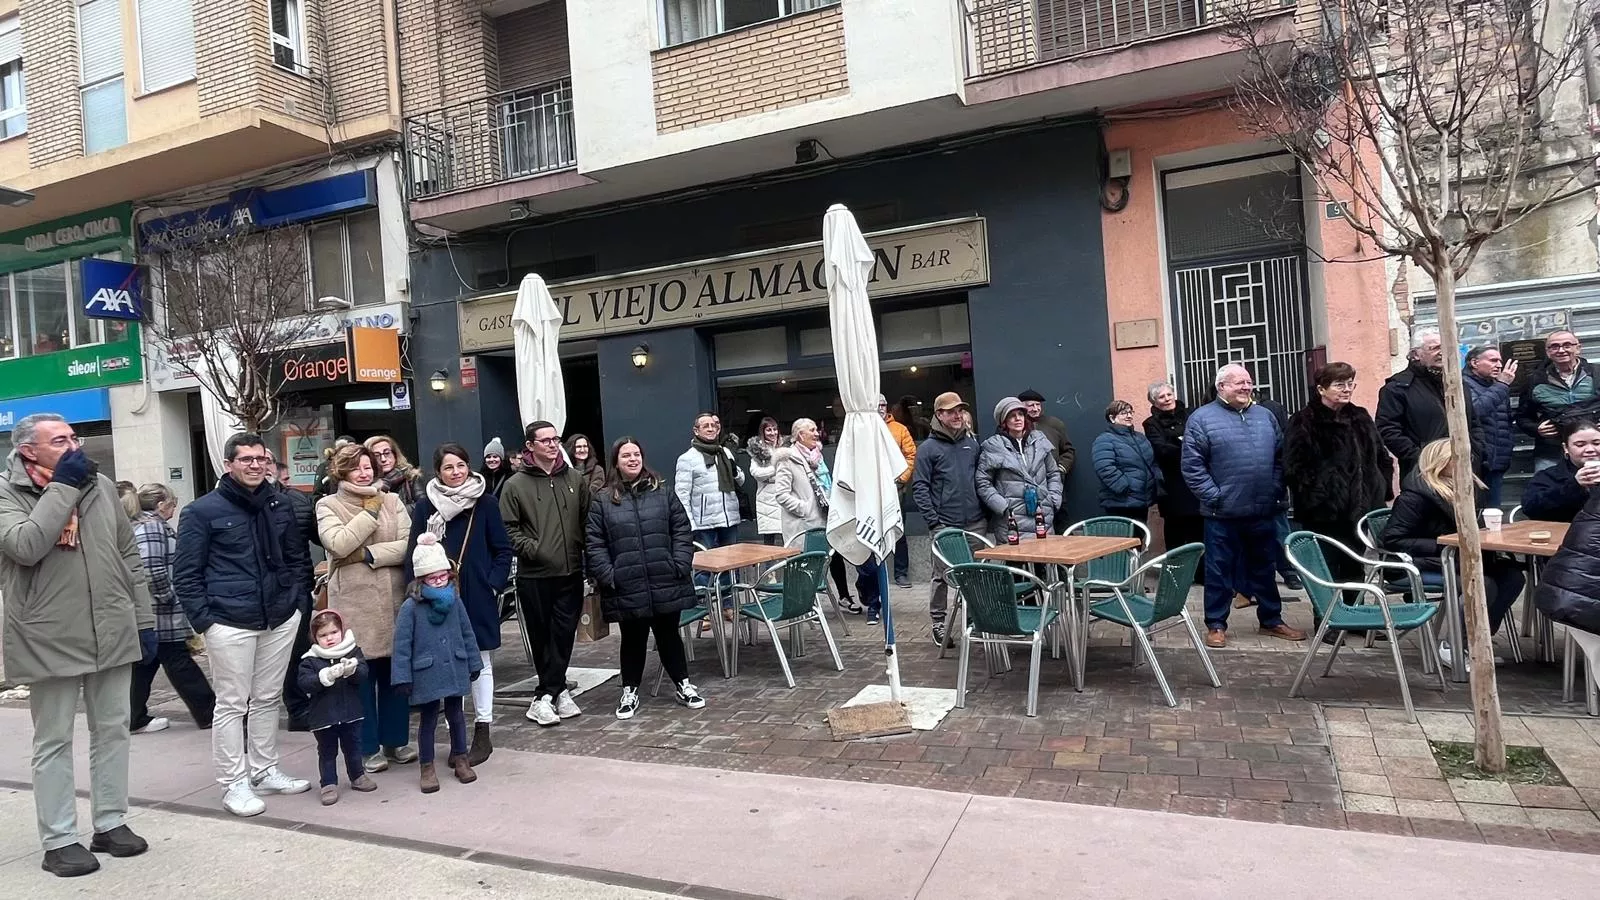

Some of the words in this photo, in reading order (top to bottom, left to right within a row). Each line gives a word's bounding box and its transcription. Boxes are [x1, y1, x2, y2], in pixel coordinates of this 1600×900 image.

[230, 207, 253, 228] AXA
[24, 231, 54, 252] ONDA
[56, 225, 83, 244] CERO
[84, 216, 119, 239] CINCA
[588, 279, 688, 325] VIEJO
[692, 244, 906, 309] ALMACN
[910, 248, 952, 270] BAR
[85, 287, 135, 314] AXA
[284, 357, 348, 381] Orange
[359, 367, 397, 380] orange
[294, 462, 319, 474] Todo
[865, 516, 875, 527] EL
